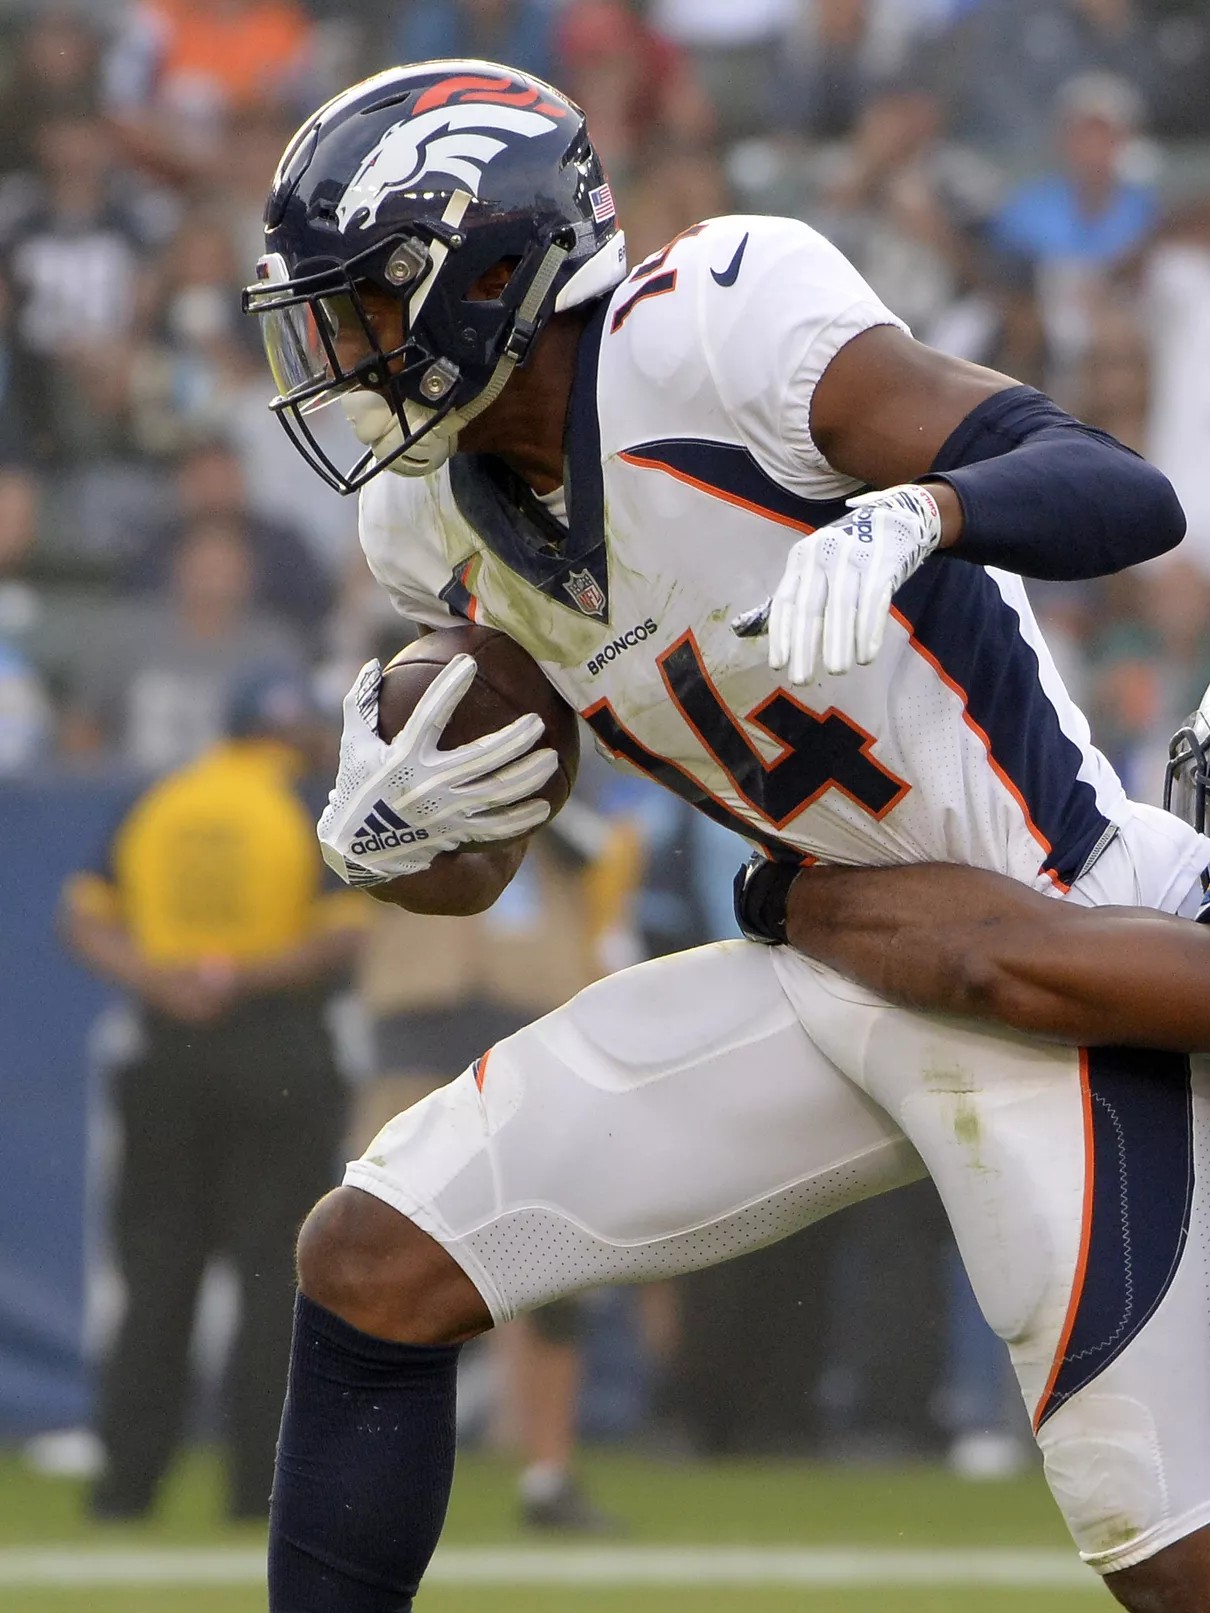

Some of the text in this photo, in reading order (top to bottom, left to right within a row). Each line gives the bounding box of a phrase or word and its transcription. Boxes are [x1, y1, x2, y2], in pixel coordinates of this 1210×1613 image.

[587, 618, 658, 675] BRONCOS
[579, 626, 912, 867] 14
[350, 828, 430, 855] adidas
